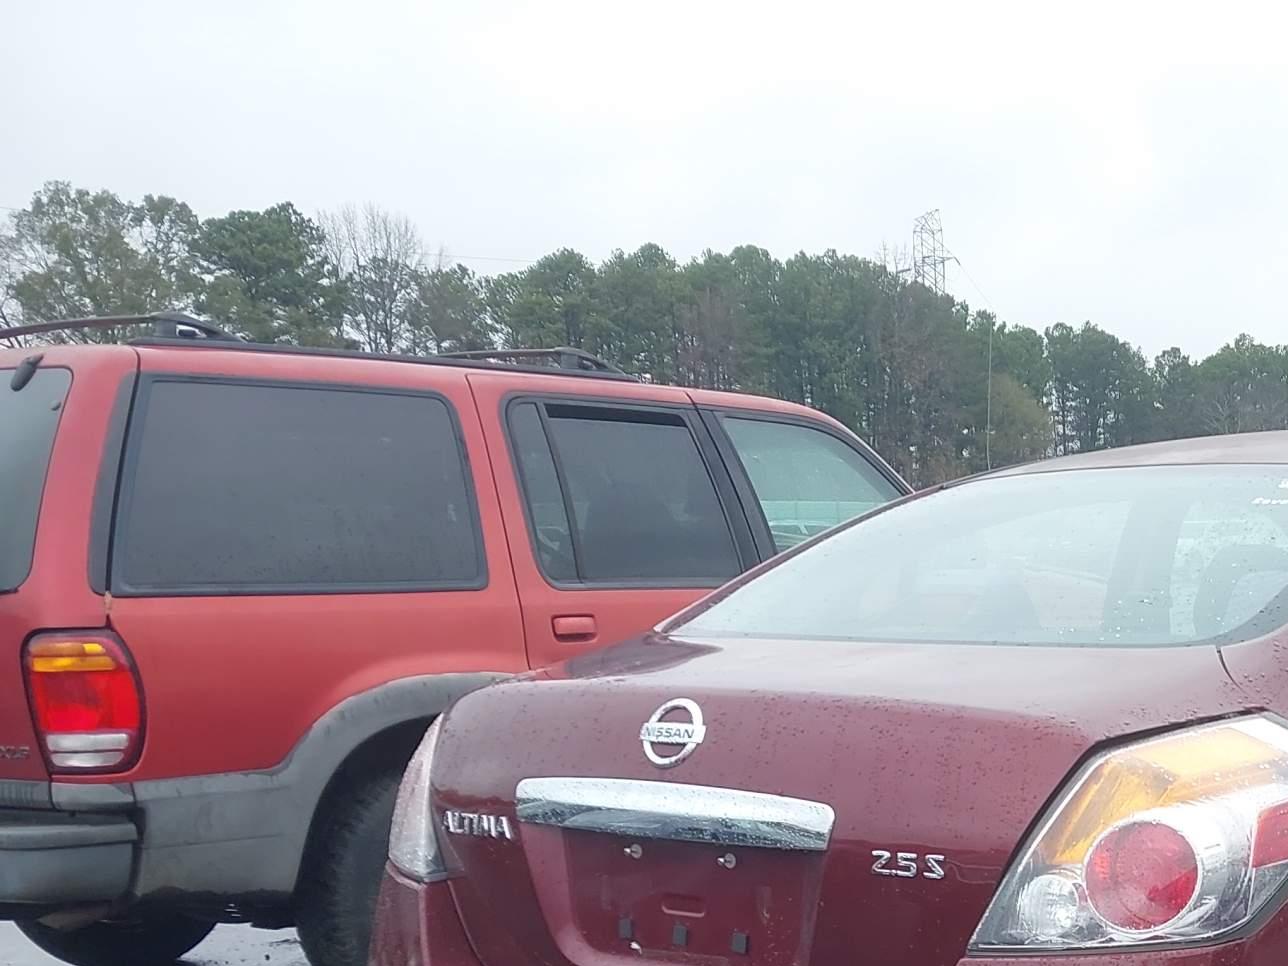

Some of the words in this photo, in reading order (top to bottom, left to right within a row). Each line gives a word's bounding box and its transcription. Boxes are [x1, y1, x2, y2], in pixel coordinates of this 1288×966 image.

[646, 726, 694, 739] NISSAN
[443, 810, 512, 840] ALTIMA
[923, 854, 945, 879] S
